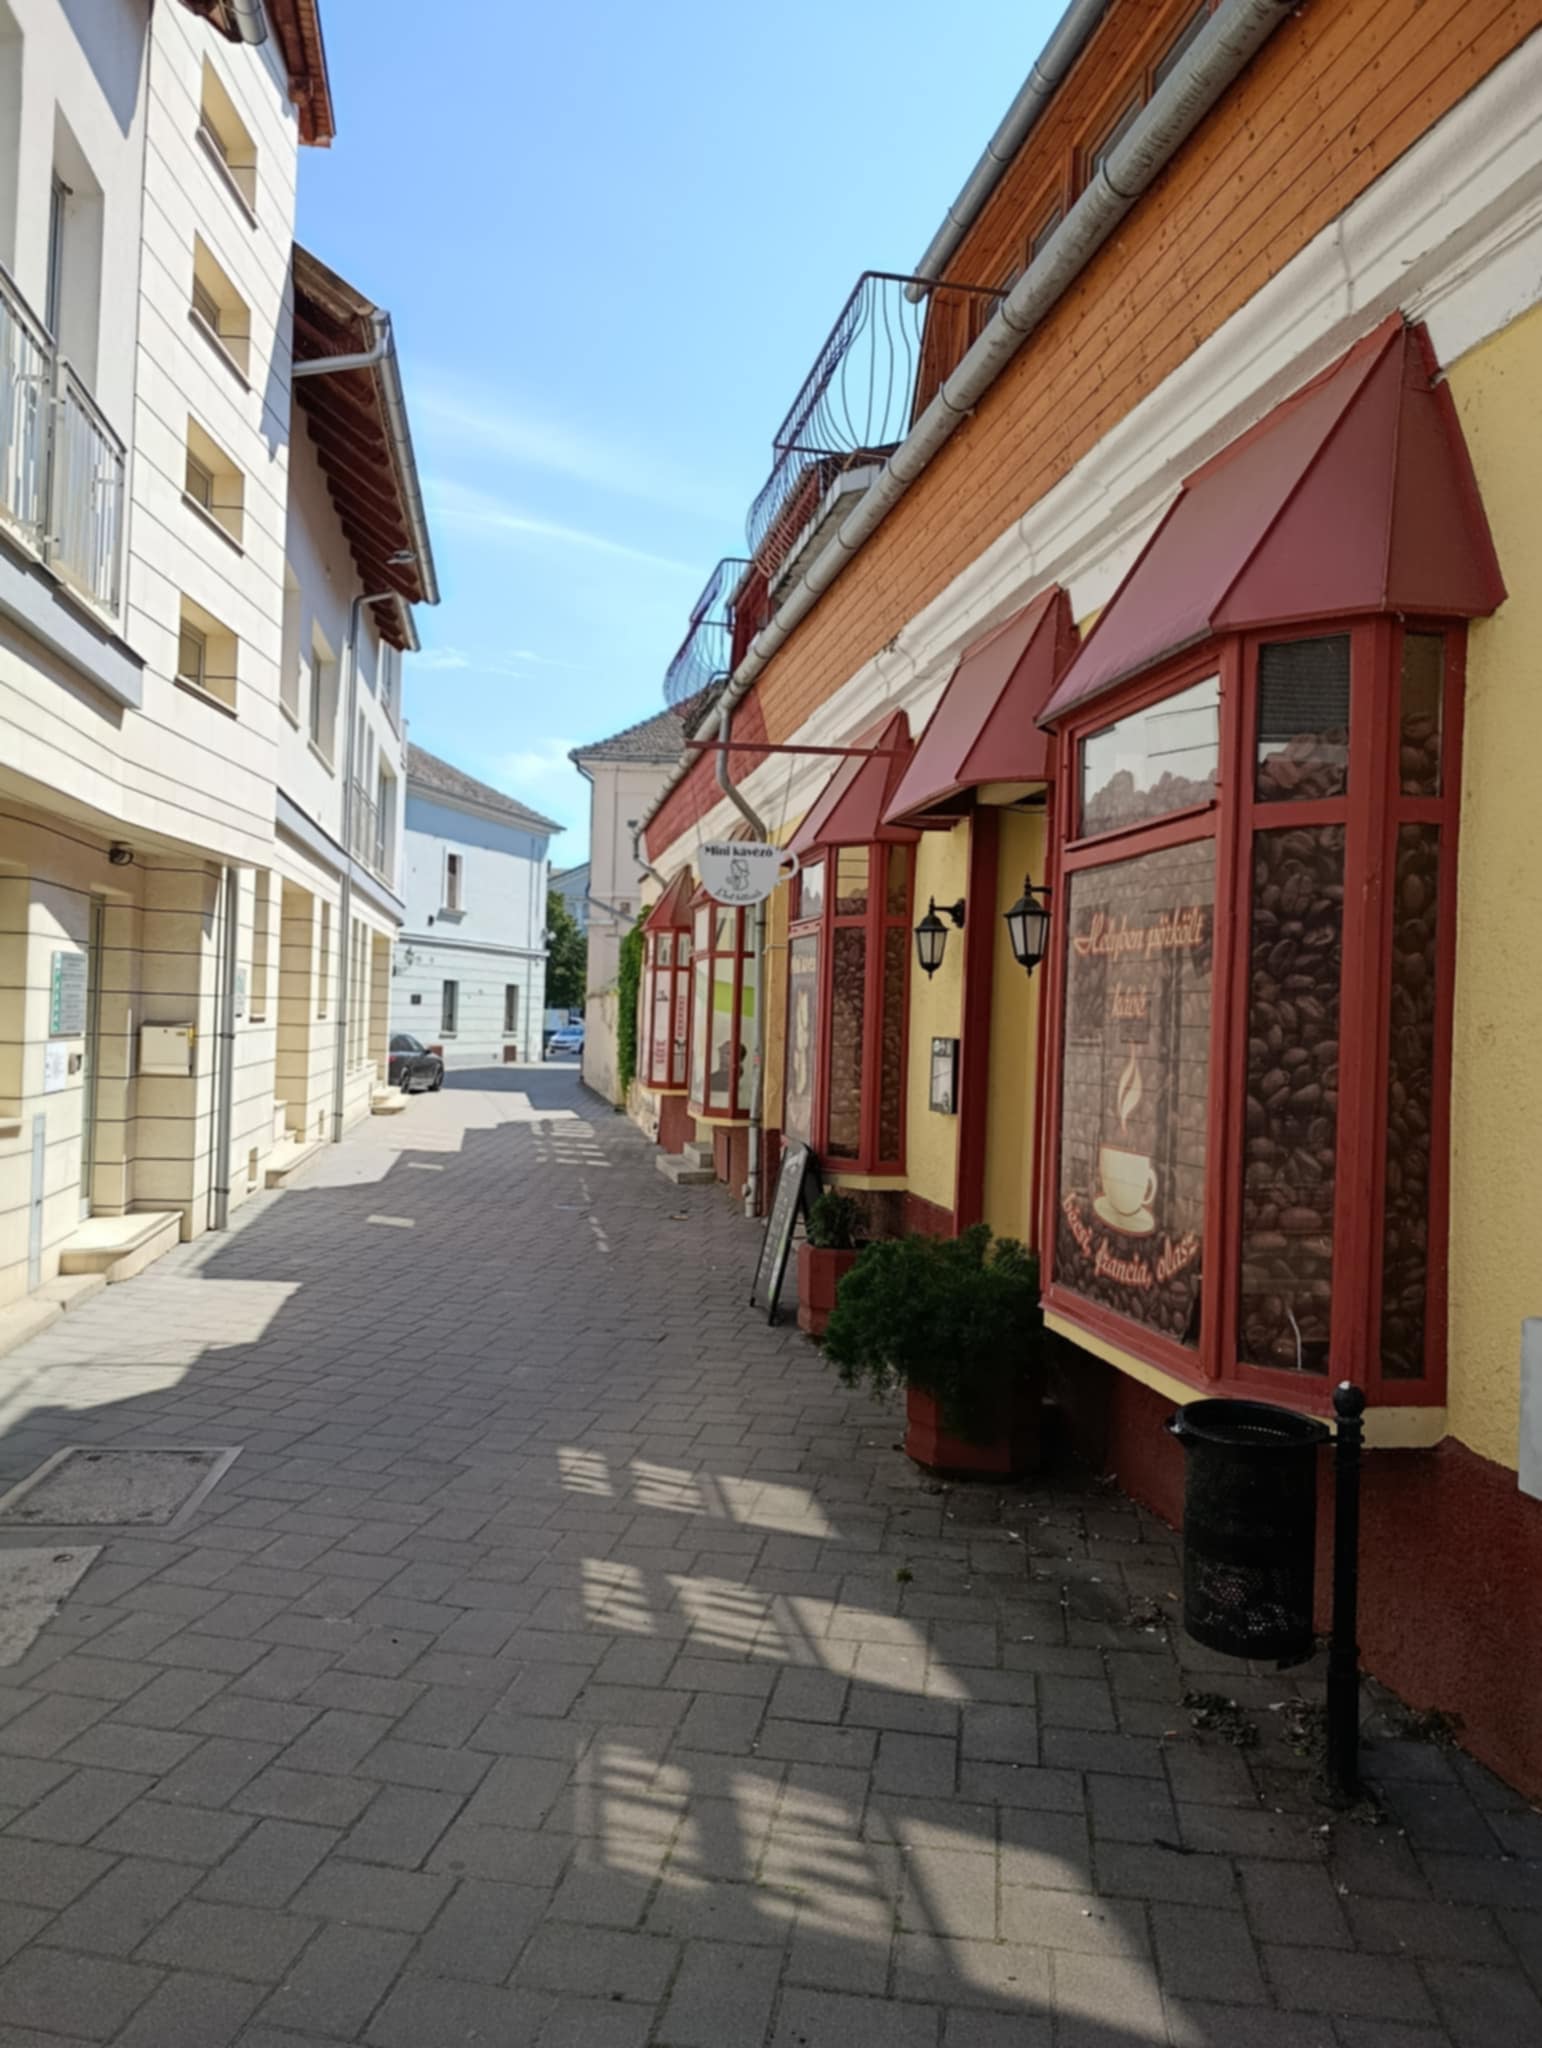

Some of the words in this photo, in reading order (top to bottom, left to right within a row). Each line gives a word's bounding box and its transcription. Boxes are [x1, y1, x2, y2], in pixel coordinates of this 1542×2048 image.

[704, 845, 731, 857] Mini
[1094, 1236, 1153, 1289] francia,
[1156, 1231, 1200, 1281] olasz
